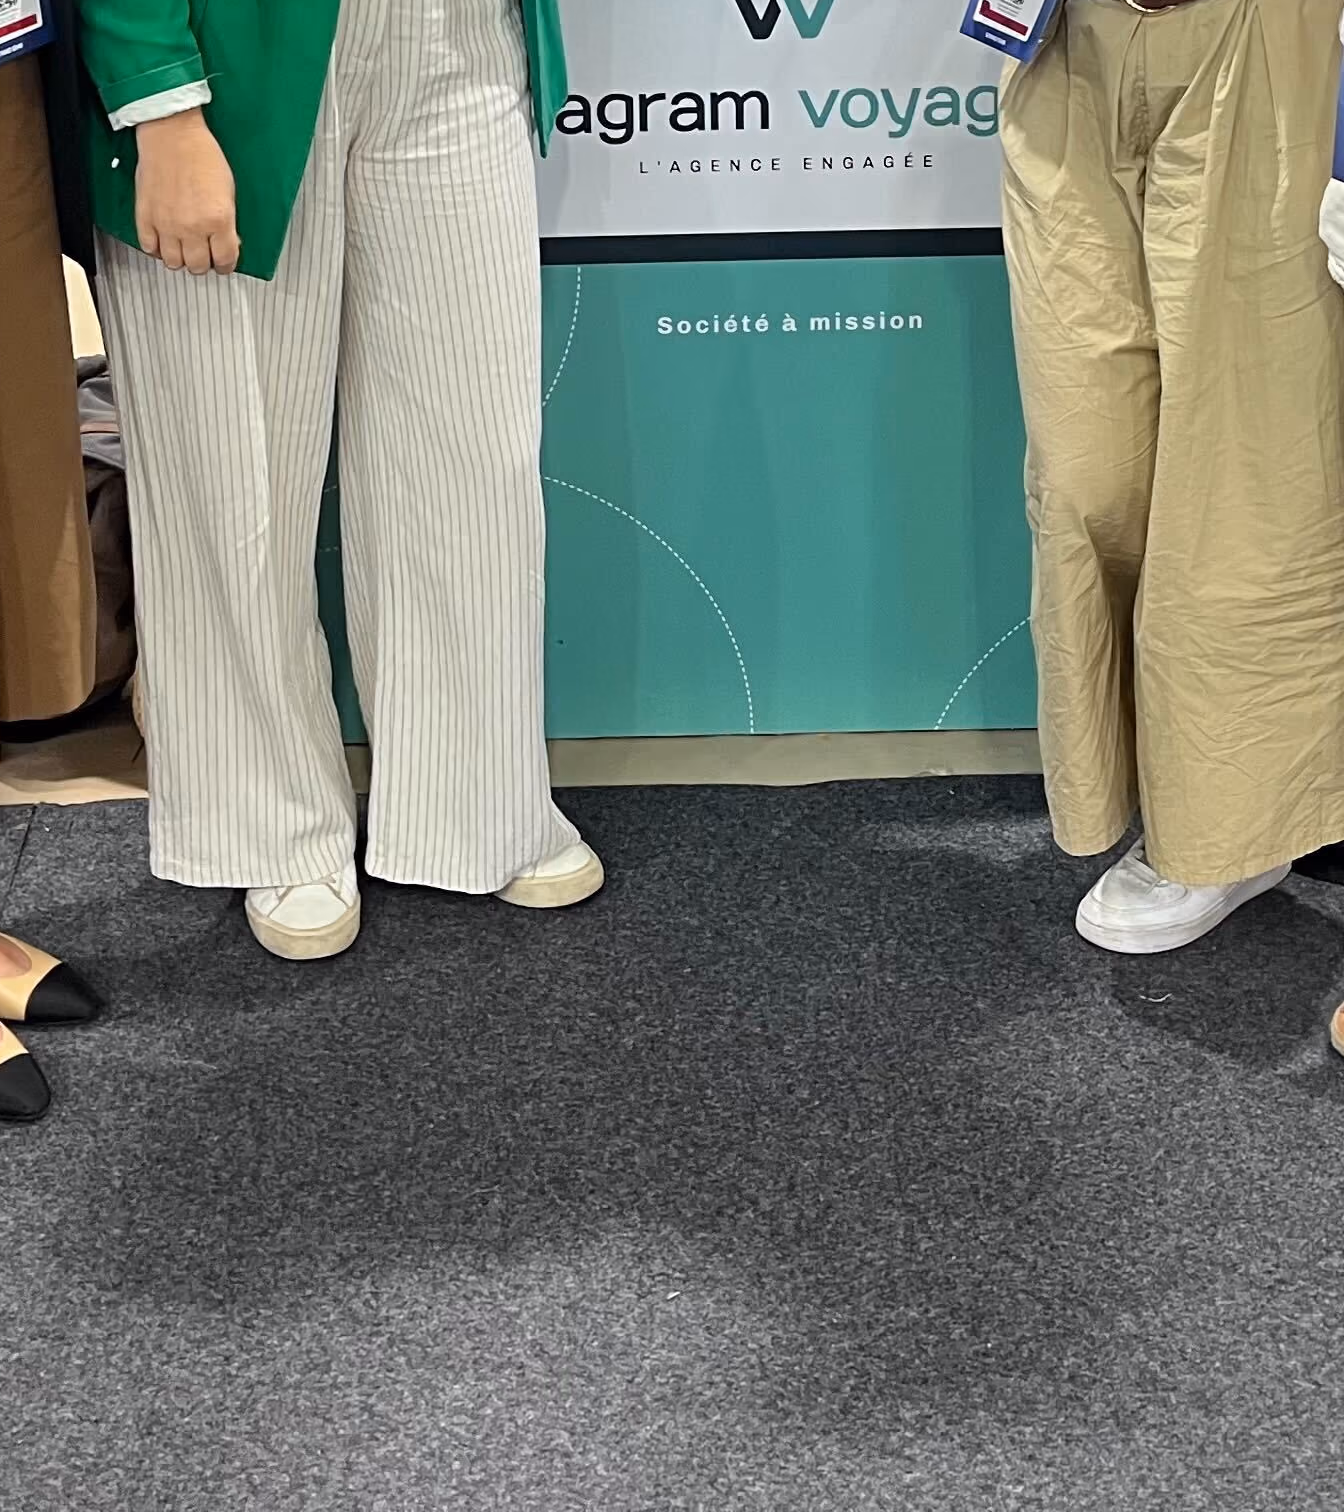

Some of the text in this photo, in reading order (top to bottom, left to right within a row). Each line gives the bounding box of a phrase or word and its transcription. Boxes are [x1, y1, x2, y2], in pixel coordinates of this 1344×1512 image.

[639, 152, 935, 175] L'AGENCE ENGAGÉE
[657, 311, 924, 335] Société à mission
